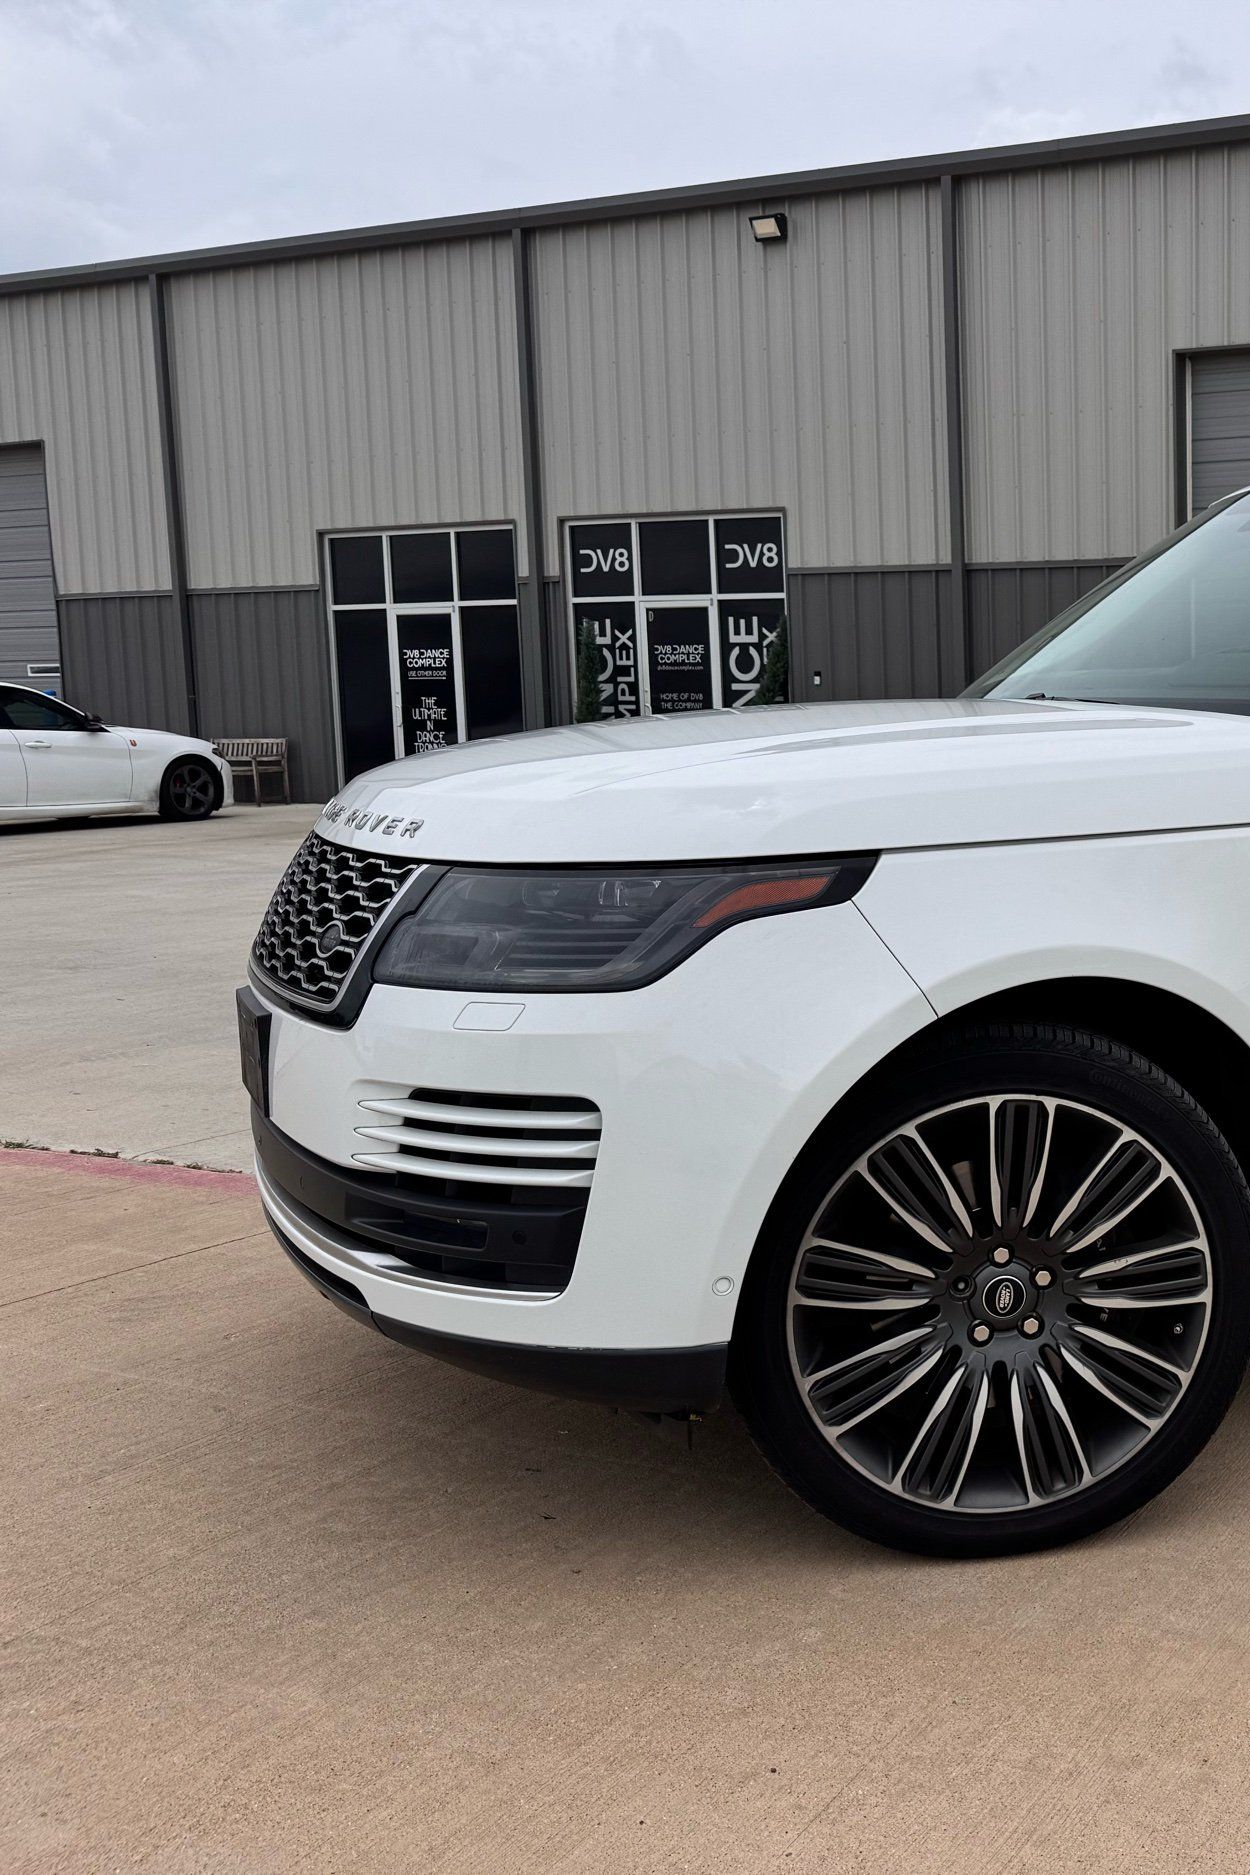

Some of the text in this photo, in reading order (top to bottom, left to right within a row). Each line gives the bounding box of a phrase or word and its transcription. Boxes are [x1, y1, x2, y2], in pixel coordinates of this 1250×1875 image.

[579, 548, 630, 573] DV8
[724, 543, 779, 568] DV8
[403, 649, 450, 659] DV8 DANCE
[654, 644, 705, 654] DV8 DANCE
[406, 658, 447, 668] COMPLEX
[658, 654, 702, 663] COMPLEX
[421, 697, 438, 709] THE
[412, 708, 447, 720] ULTIMATE
[416, 731, 446, 743] DANCE
[344, 808, 425, 839] ROVER
